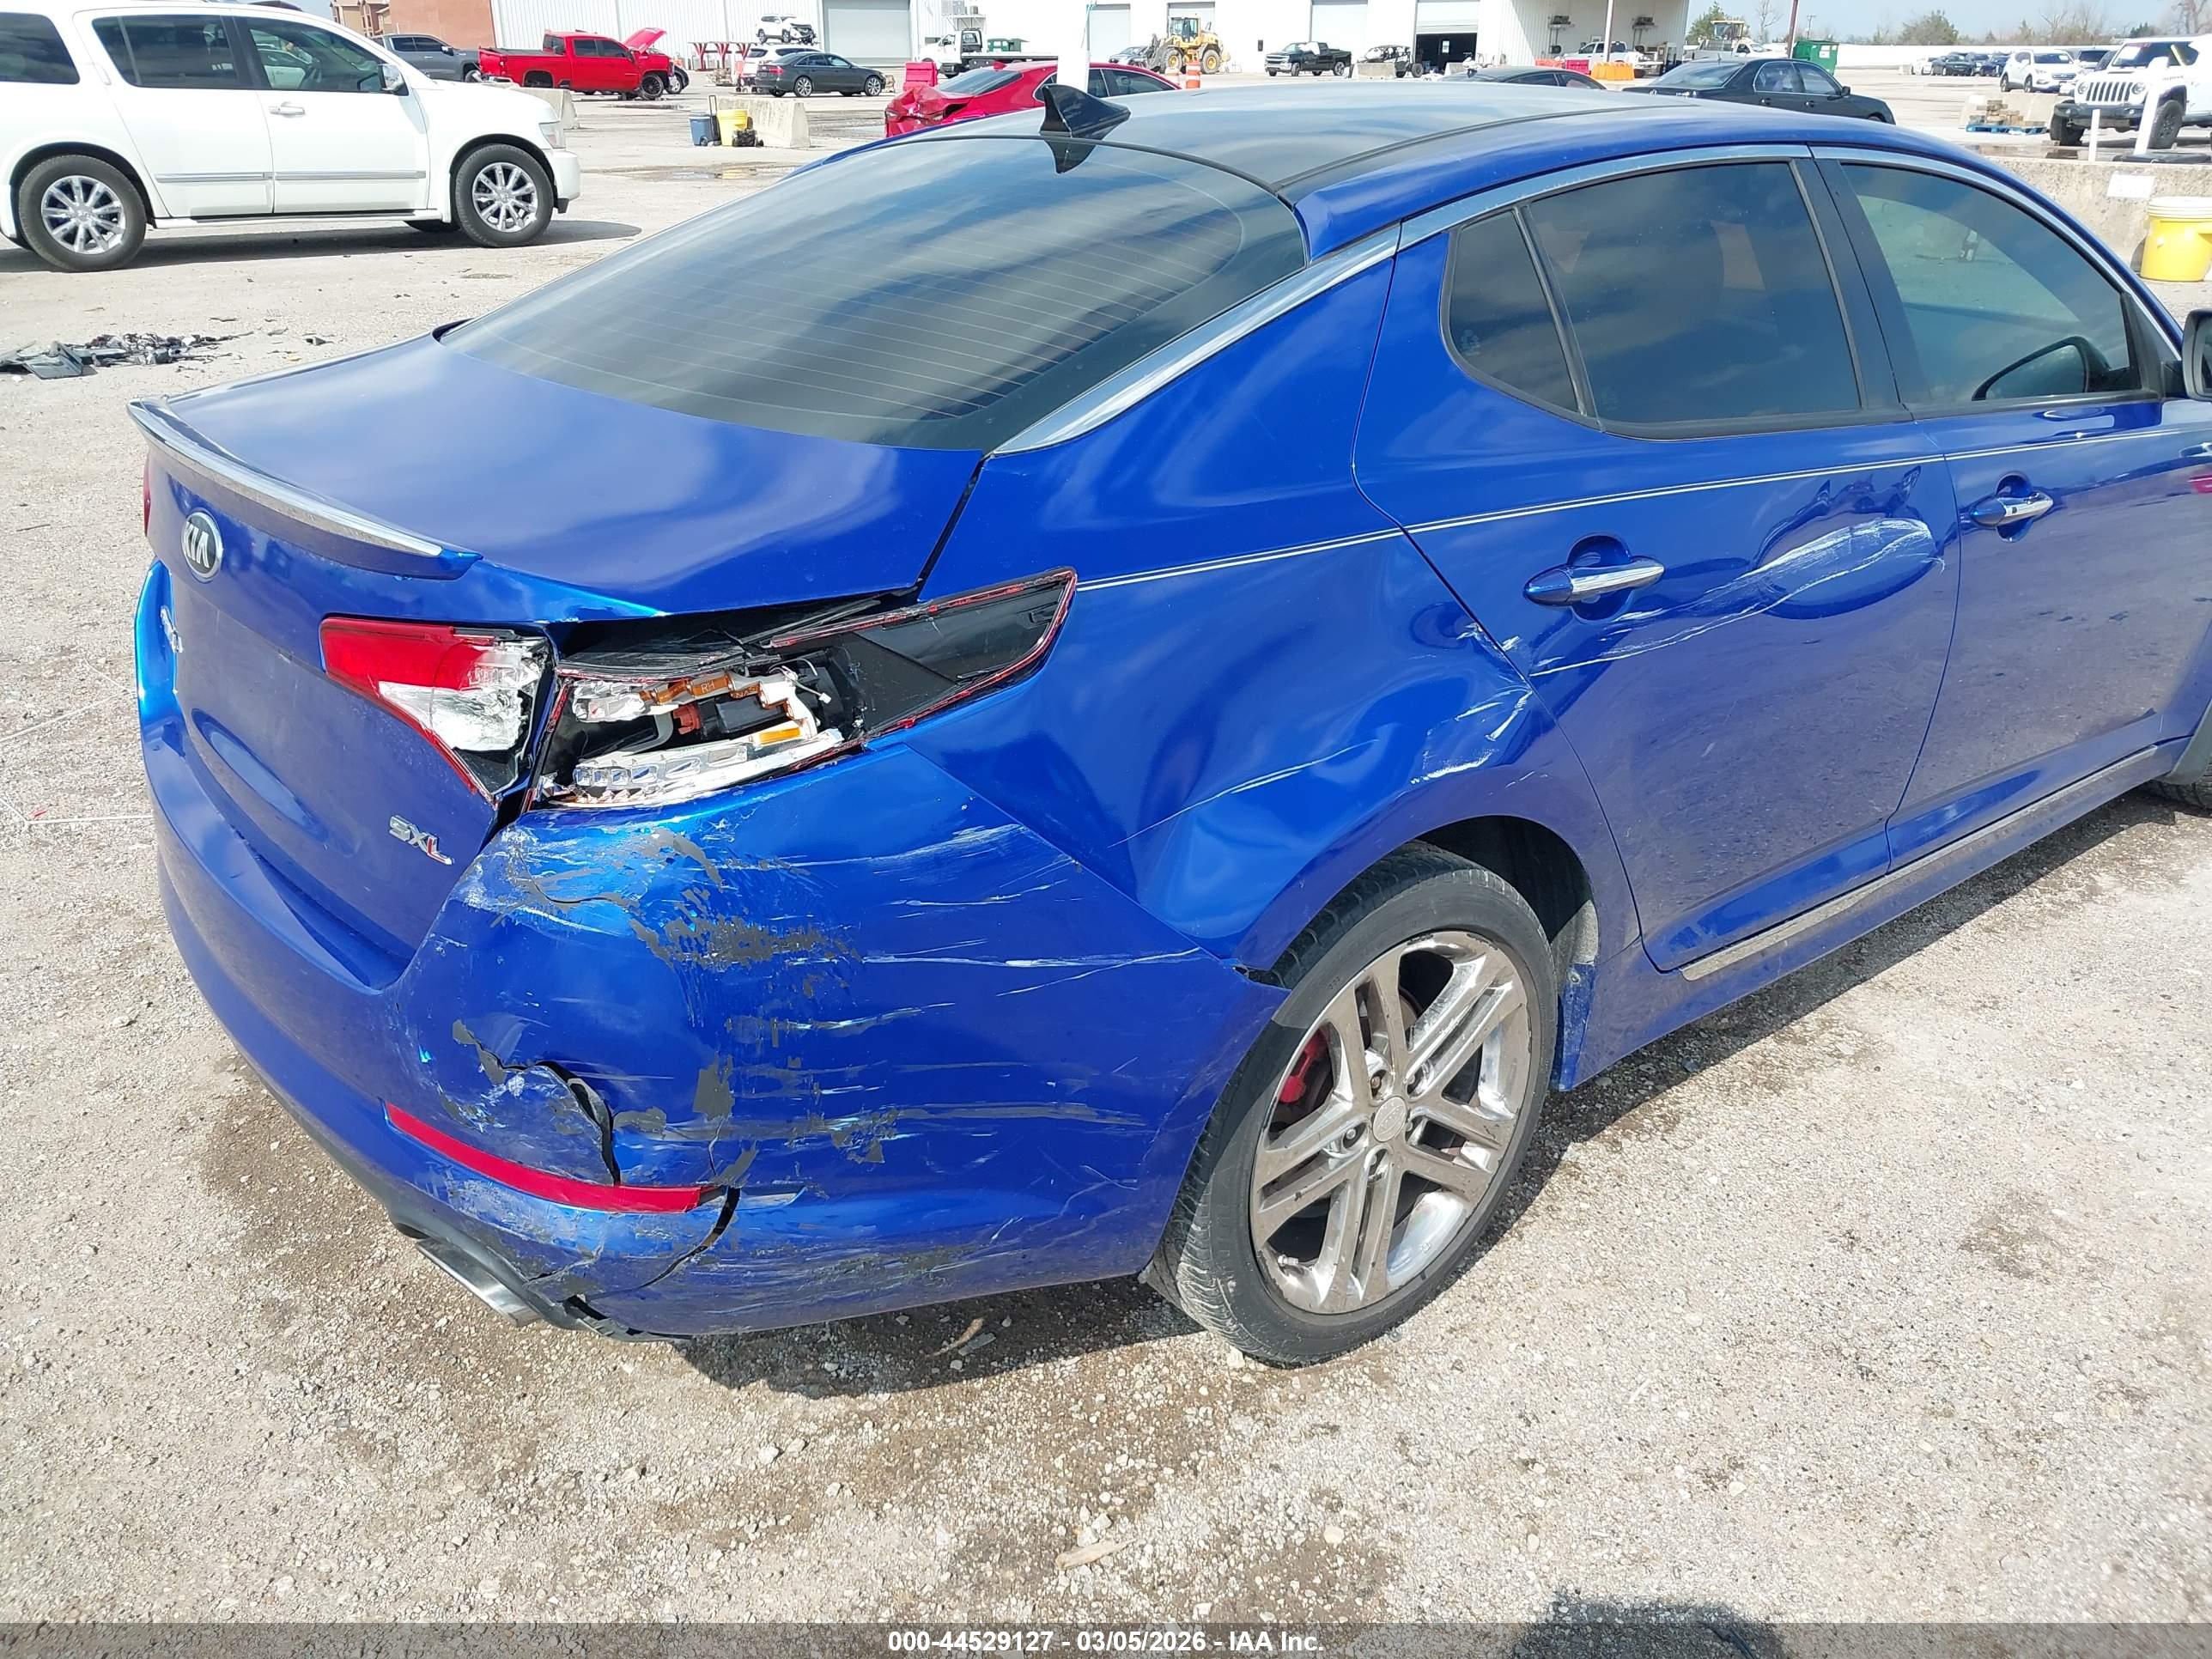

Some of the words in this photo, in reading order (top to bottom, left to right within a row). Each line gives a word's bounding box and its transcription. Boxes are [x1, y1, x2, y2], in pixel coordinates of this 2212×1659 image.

[183, 520, 210, 568] KIA
[701, 681, 715, 694] RH
[389, 815, 454, 865] SXL
